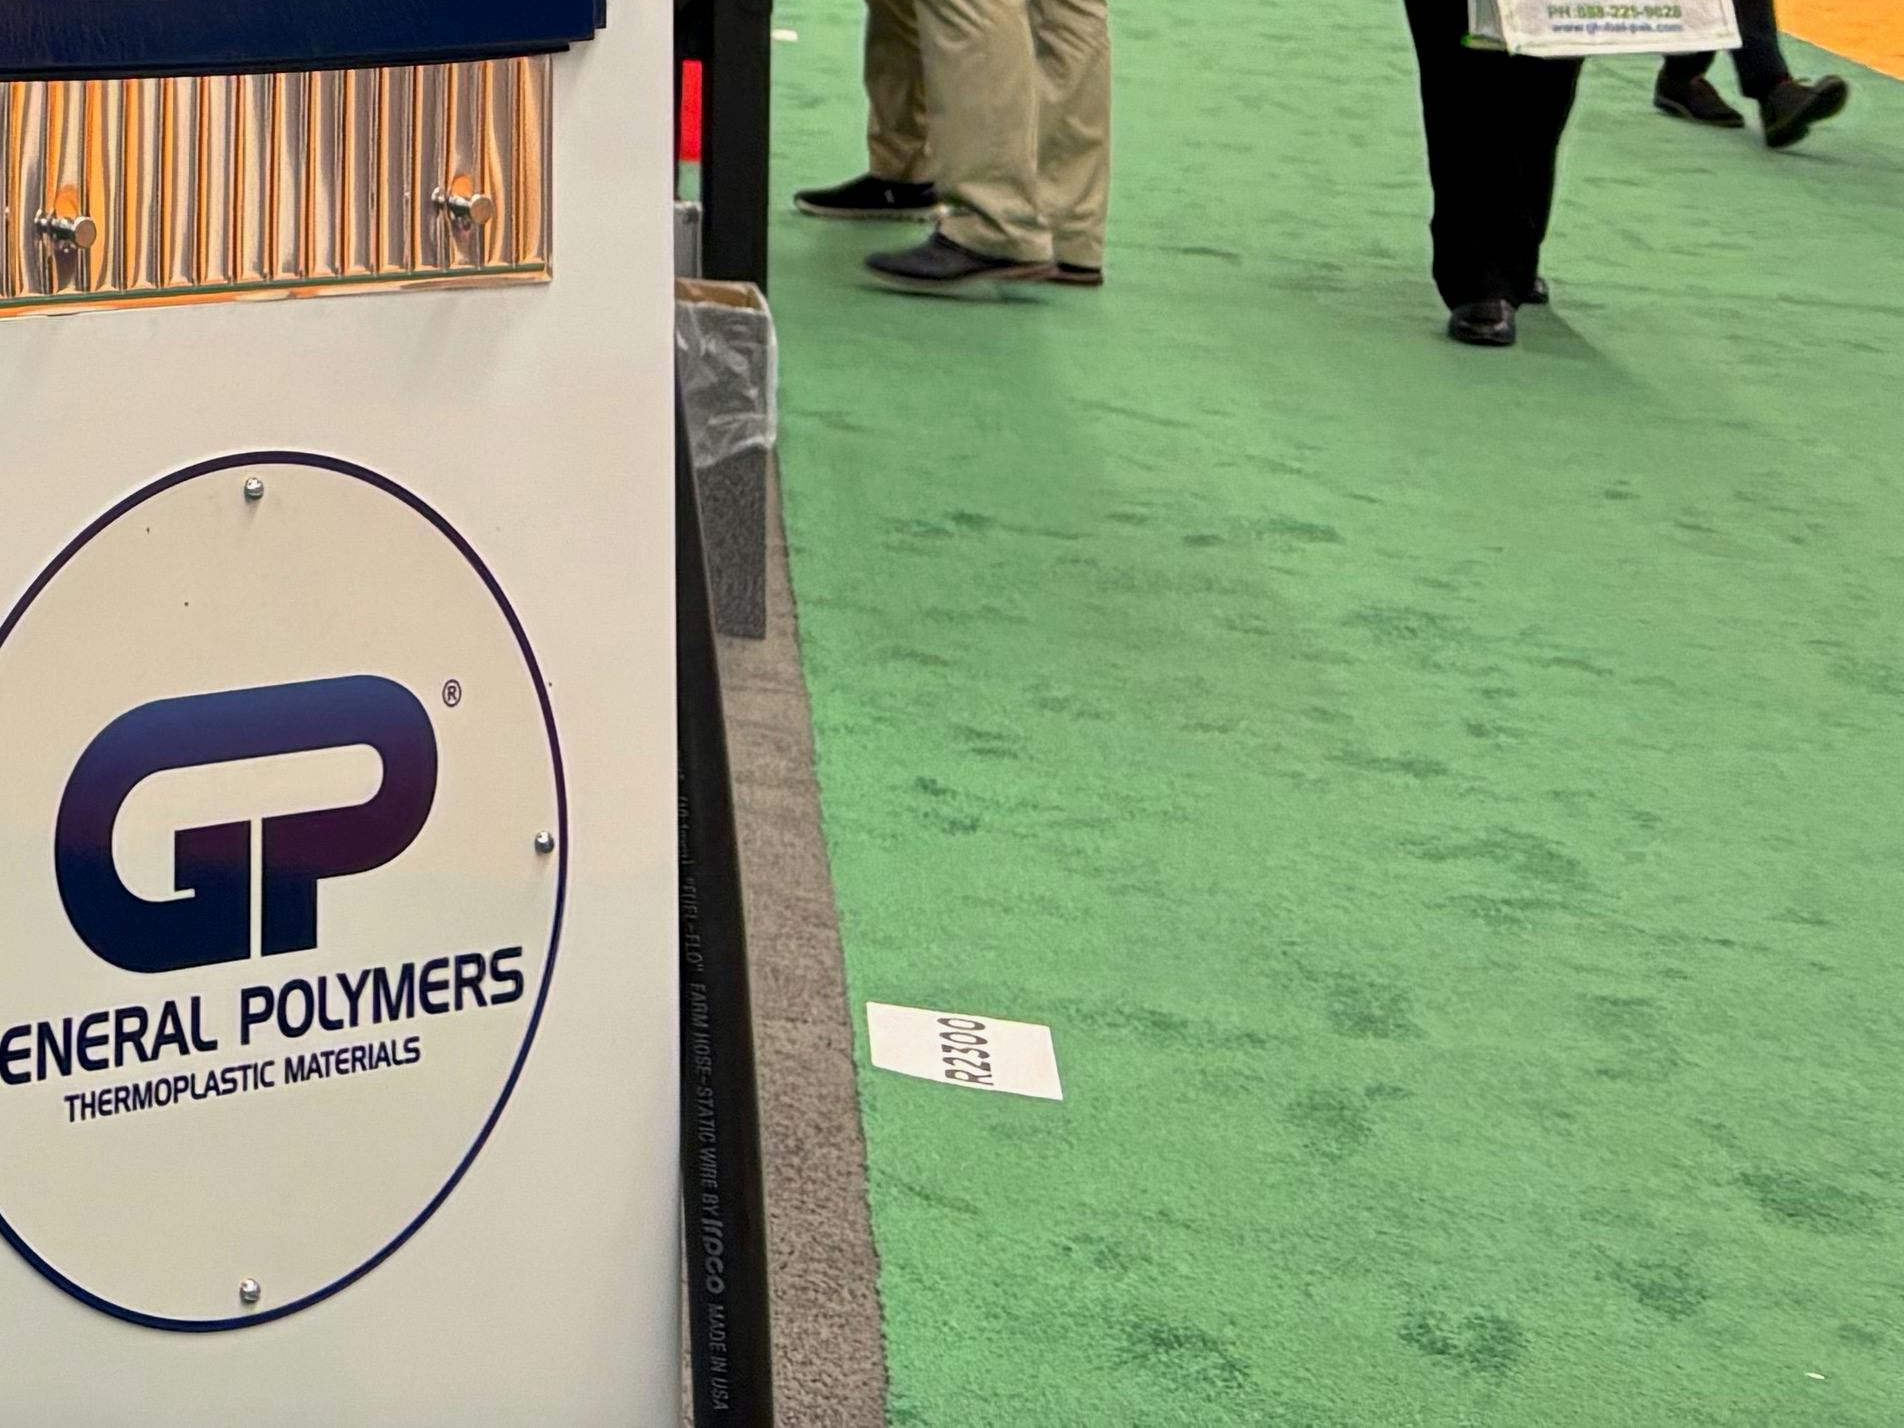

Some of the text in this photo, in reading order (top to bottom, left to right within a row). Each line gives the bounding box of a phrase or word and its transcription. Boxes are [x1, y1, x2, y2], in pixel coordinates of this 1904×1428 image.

[54, 674, 438, 974] GP
[240, 946, 524, 1046] POLYMERS
[688, 982, 710, 1028] FARM
[937, 1017, 994, 1086] R2300
[63, 1036, 421, 1124] THERMOPLASTIC MATERIALS
[692, 1033, 717, 1144] HOSE-STATIC
[699, 1147, 719, 1190] WIRE
[702, 1193, 720, 1217] BY
[708, 1303, 728, 1353] MADE
[710, 1355, 729, 1373] IN
[711, 1378, 730, 1411] USA
